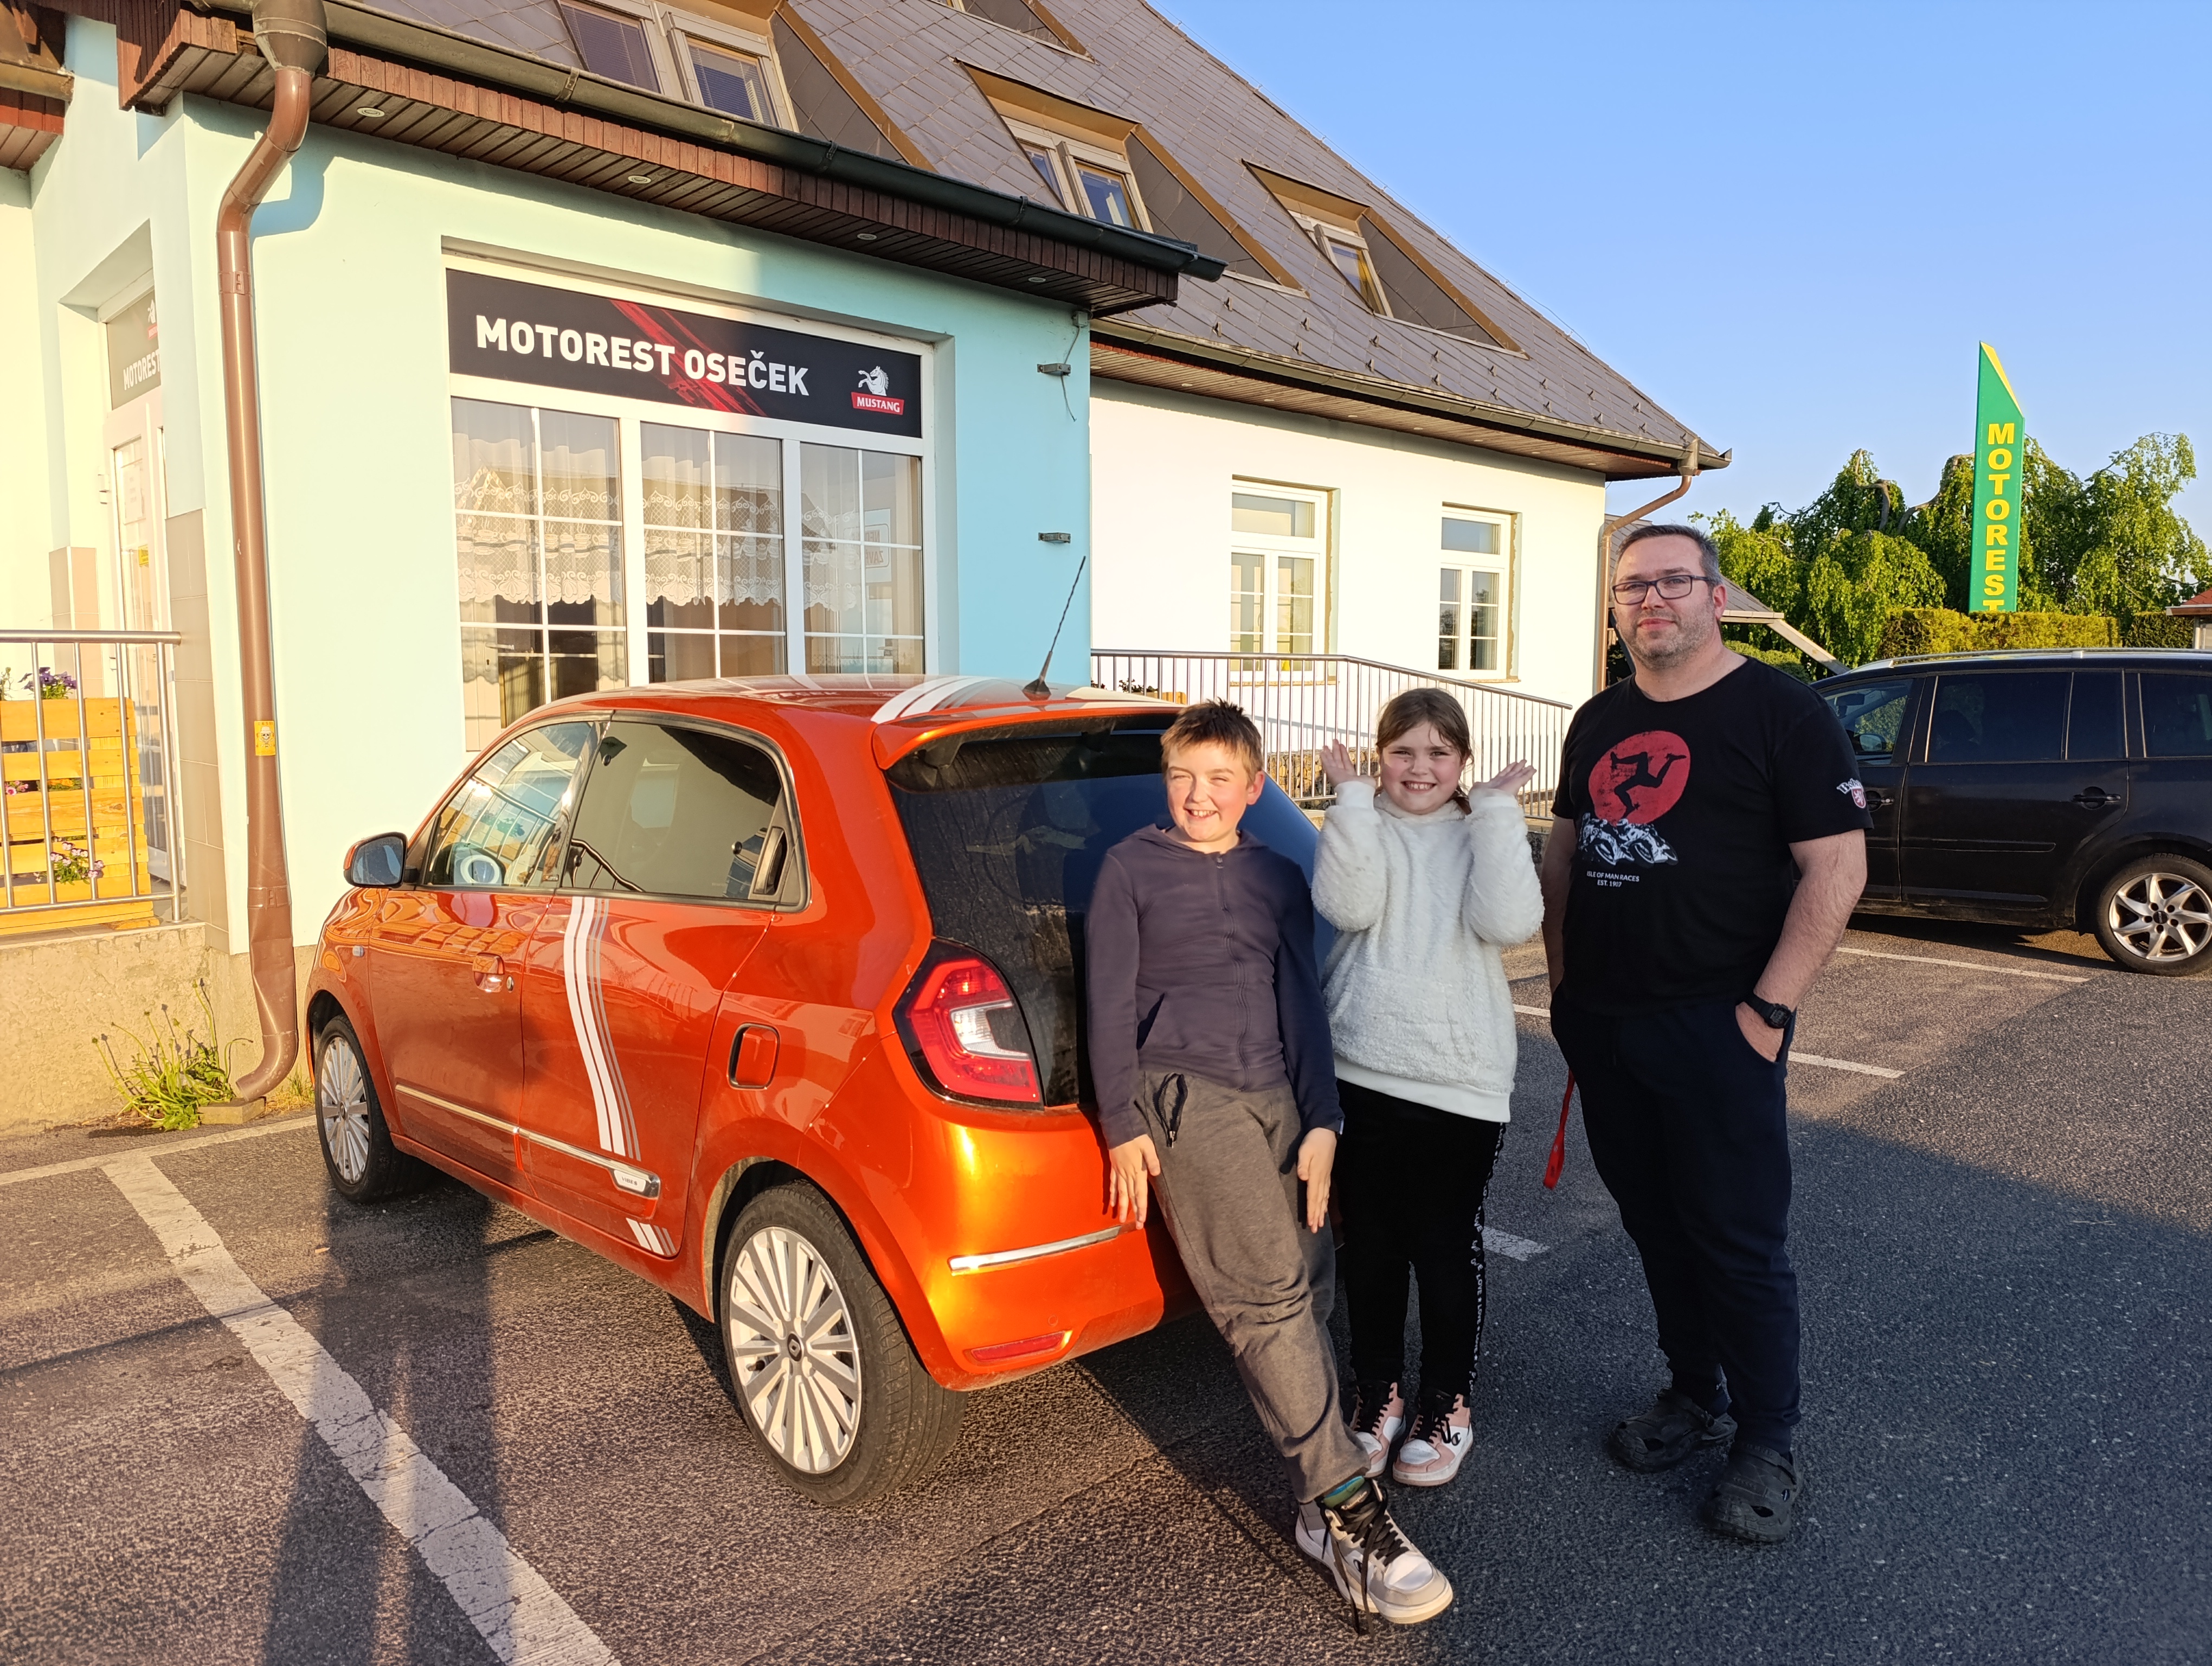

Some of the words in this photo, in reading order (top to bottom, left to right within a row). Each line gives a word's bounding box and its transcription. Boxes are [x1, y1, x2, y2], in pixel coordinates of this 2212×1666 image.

[123, 350, 160, 390] MOTOREST
[477, 315, 676, 375] MOTOREST
[684, 350, 809, 396] OSEČEK
[857, 396, 900, 413] MUSTANG
[1983, 423, 2015, 611] MOTOREST
[621, 1176, 638, 1186] VIBES
